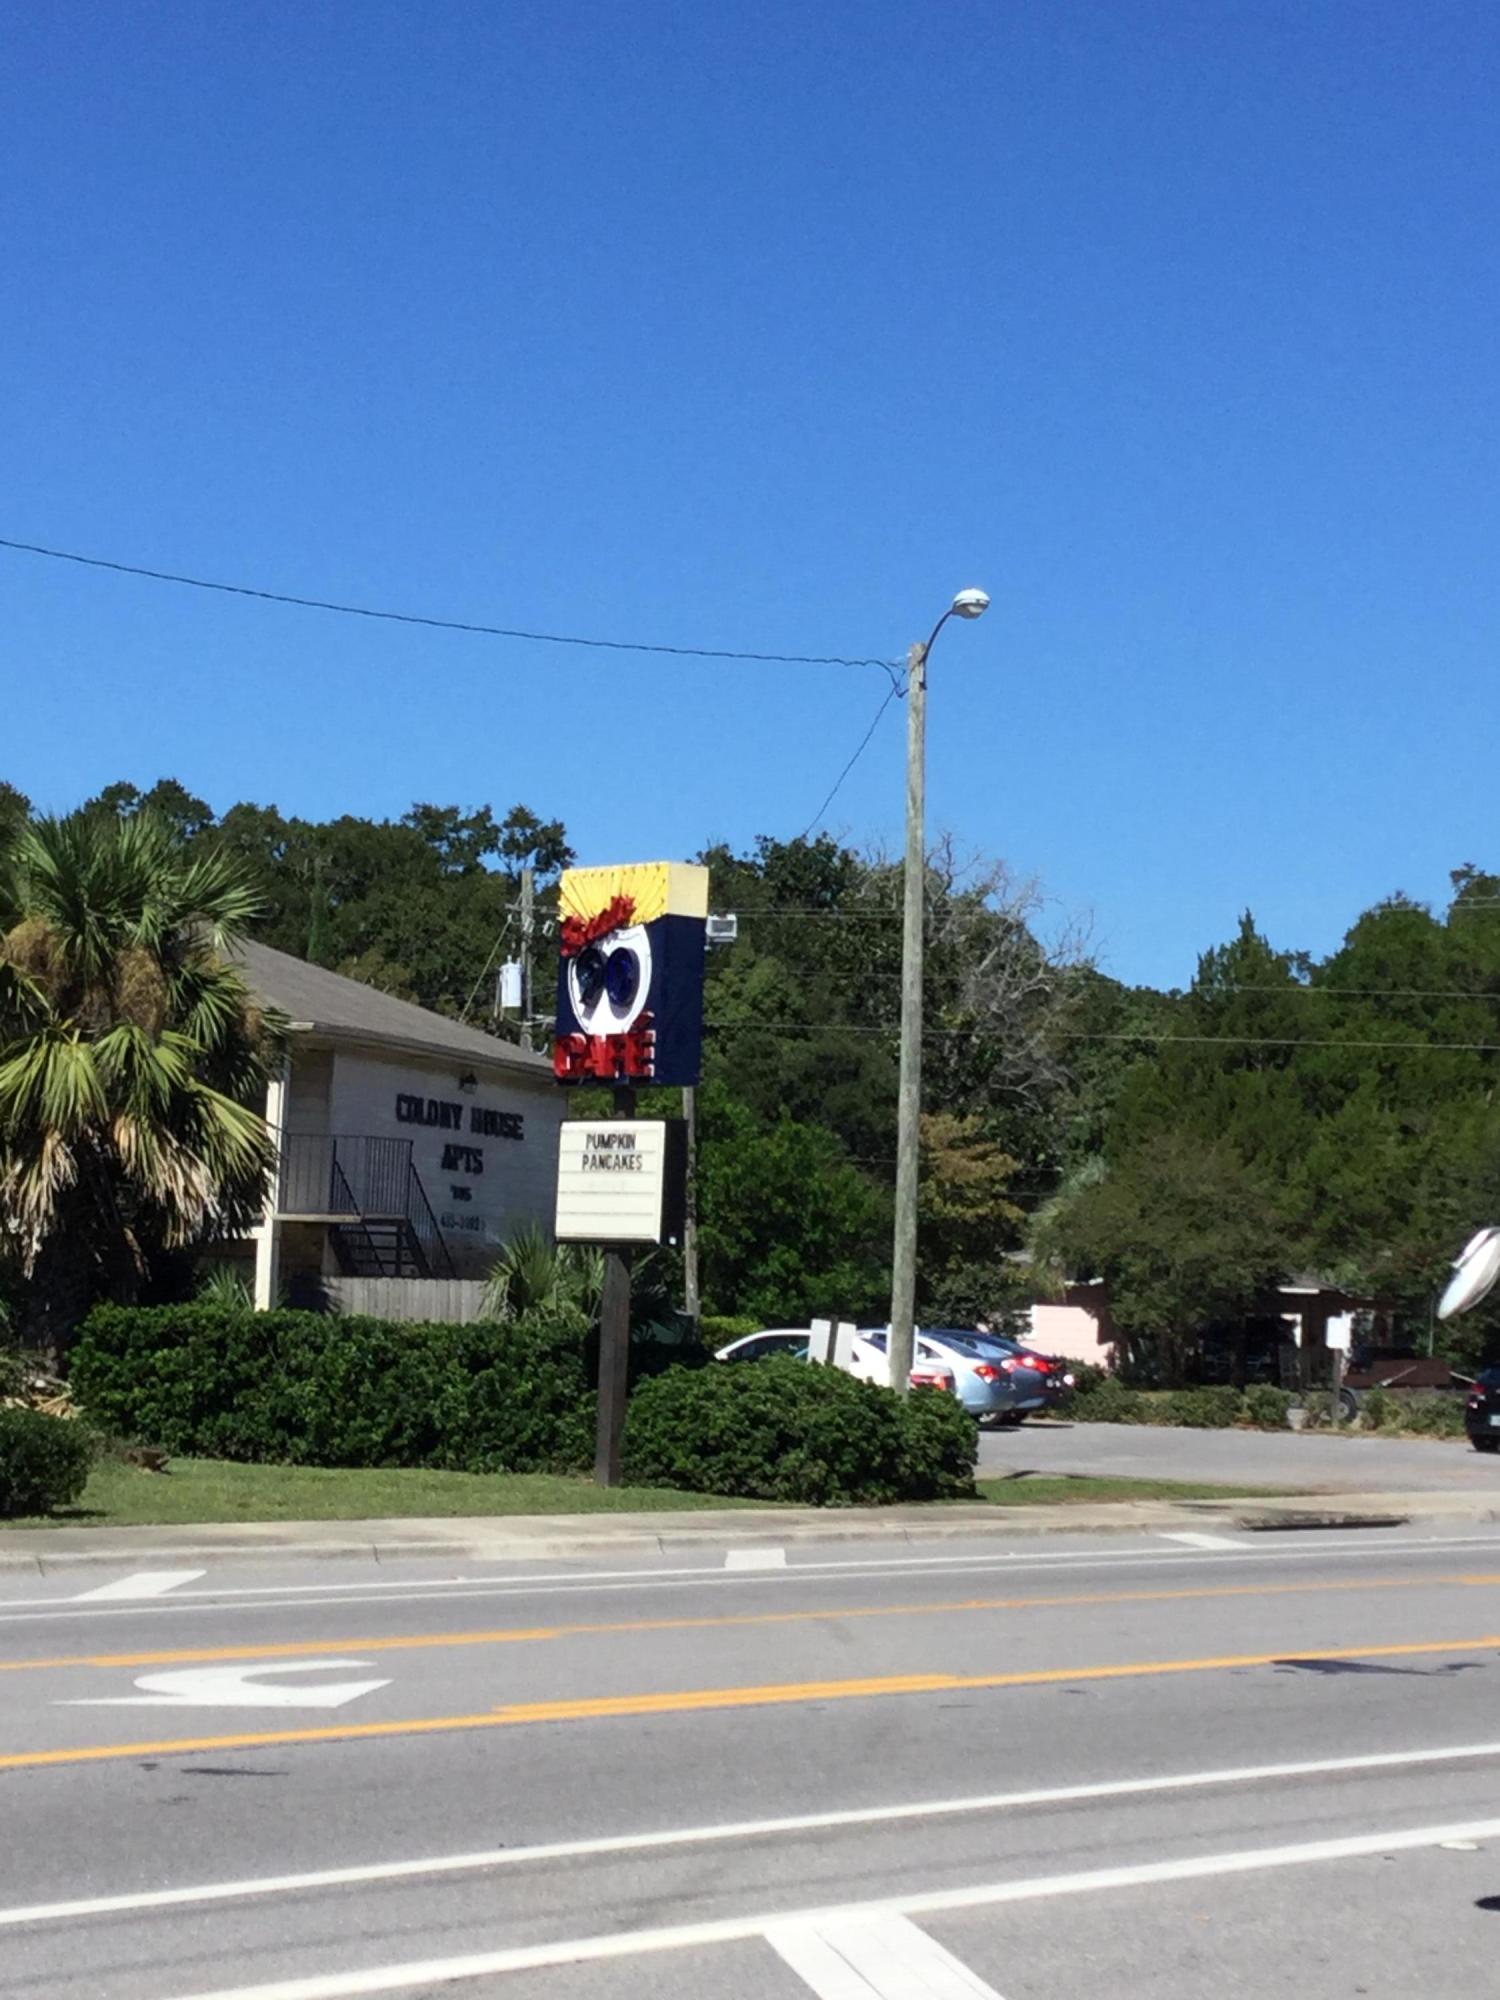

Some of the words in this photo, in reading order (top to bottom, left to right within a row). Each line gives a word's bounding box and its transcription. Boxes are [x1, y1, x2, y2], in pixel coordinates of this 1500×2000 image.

[396, 1093, 463, 1130] COLONY
[470, 1107, 524, 1140] HOUSE
[585, 1133, 637, 1149] PUMPKIN
[441, 1143, 484, 1174] APTS
[582, 1153, 643, 1171] PANCAKES
